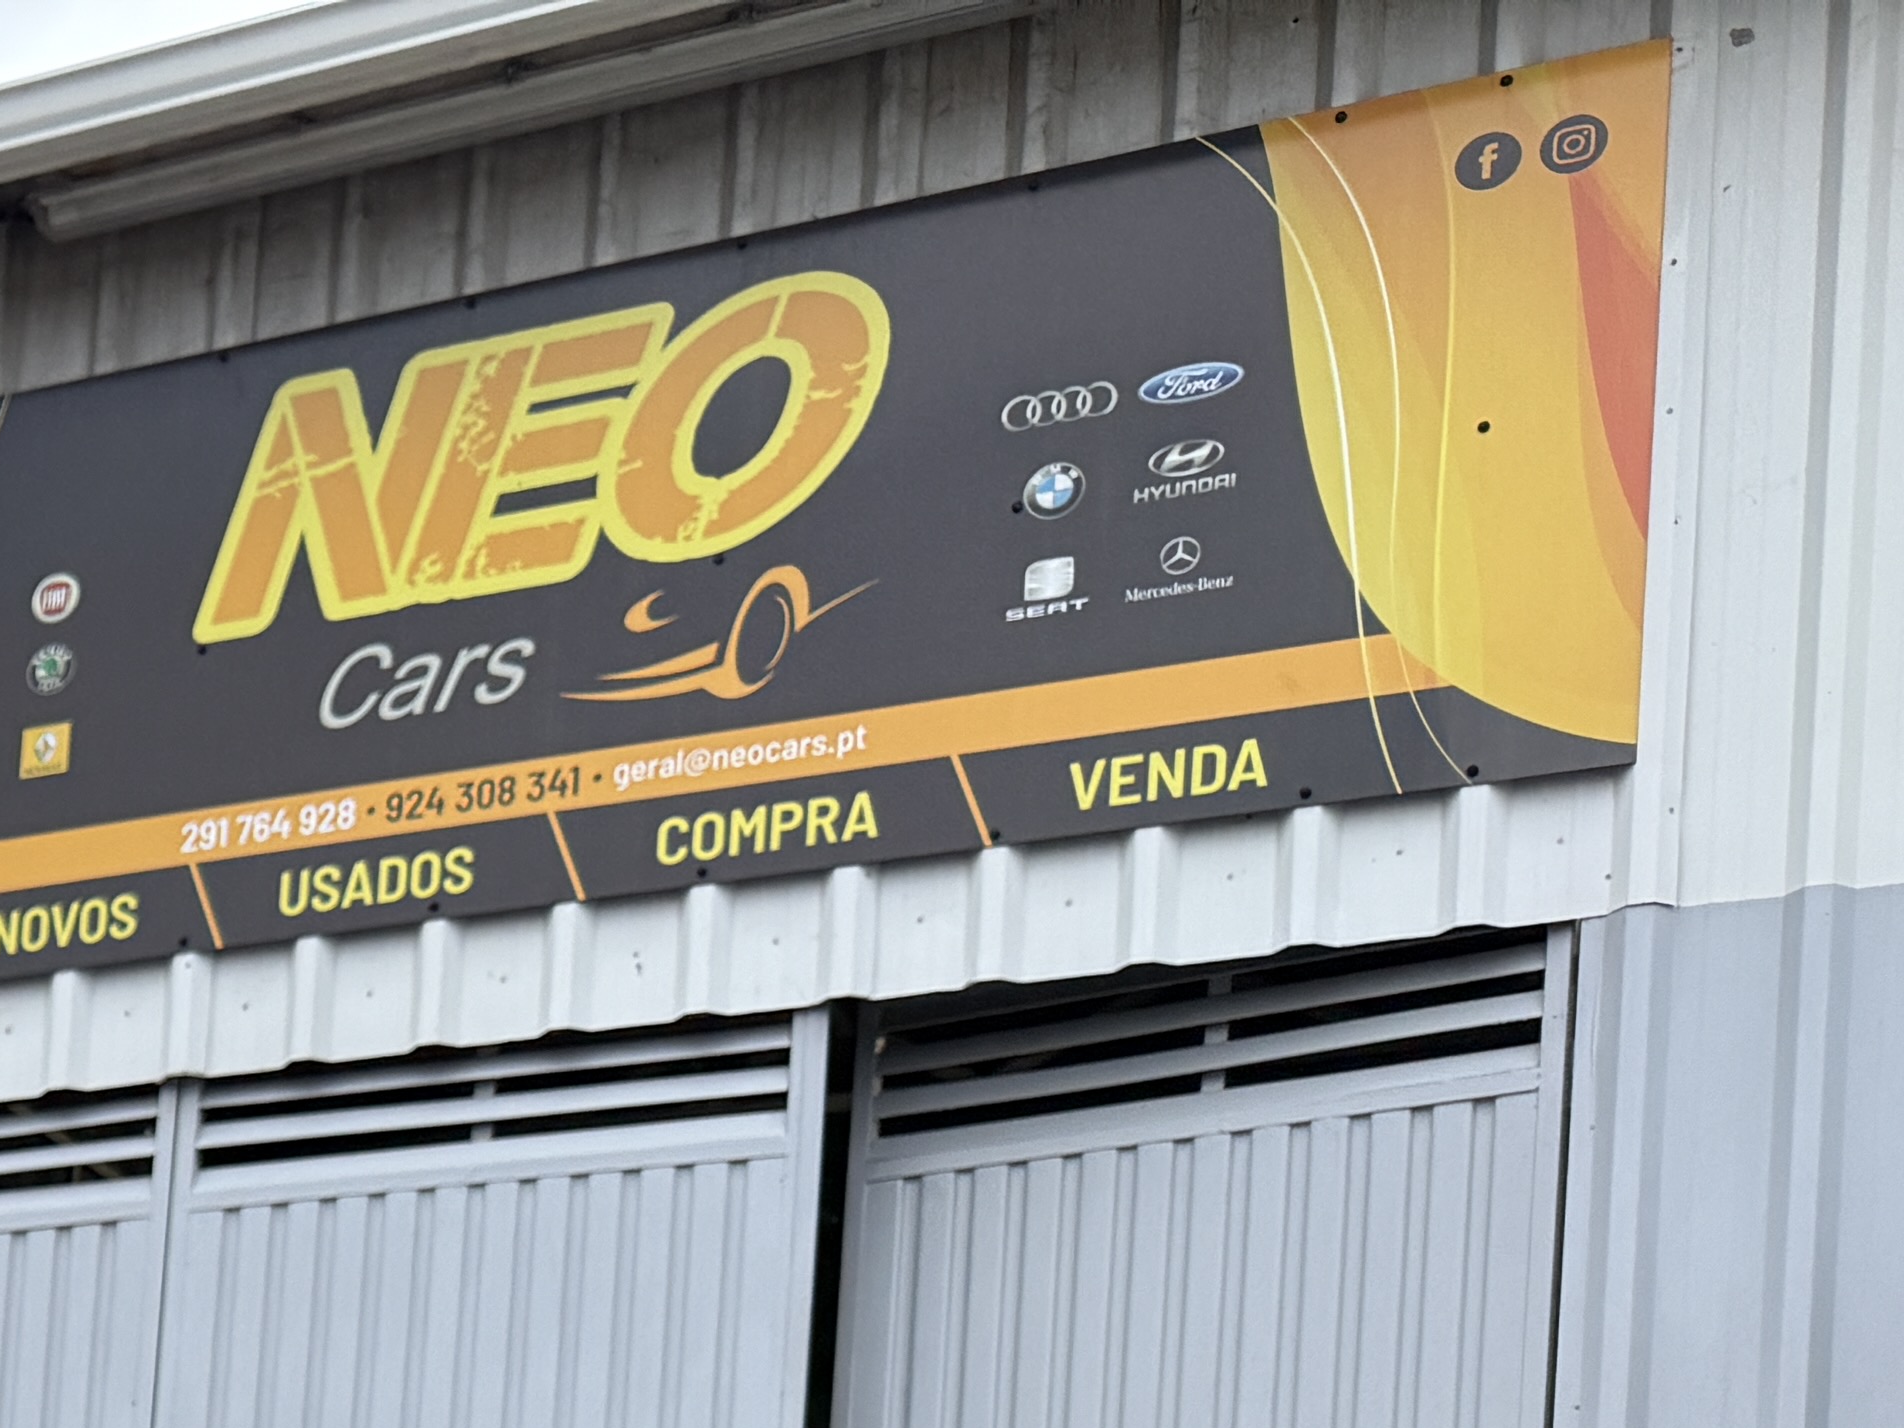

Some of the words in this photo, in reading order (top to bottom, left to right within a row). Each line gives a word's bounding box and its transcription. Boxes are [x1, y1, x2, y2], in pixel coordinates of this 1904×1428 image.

[1157, 368, 1224, 400] Ford
[192, 271, 891, 644] NEO
[1133, 472, 1237, 504] HYUNDAI
[1005, 597, 1089, 622] SEAT
[1124, 575, 1234, 603] Mercedes-Benz
[318, 636, 535, 730] Cars
[179, 816, 230, 854] 291
[236, 807, 292, 845] 764
[299, 797, 358, 837] 928
[385, 785, 445, 823] 924
[454, 774, 517, 813] 308
[525, 764, 581, 802] 341
[612, 724, 868, 792] geral@neocars.pt
[277, 845, 475, 917] USADOS
[655, 789, 880, 867] COMPRA
[1068, 736, 1269, 811] VENDA
